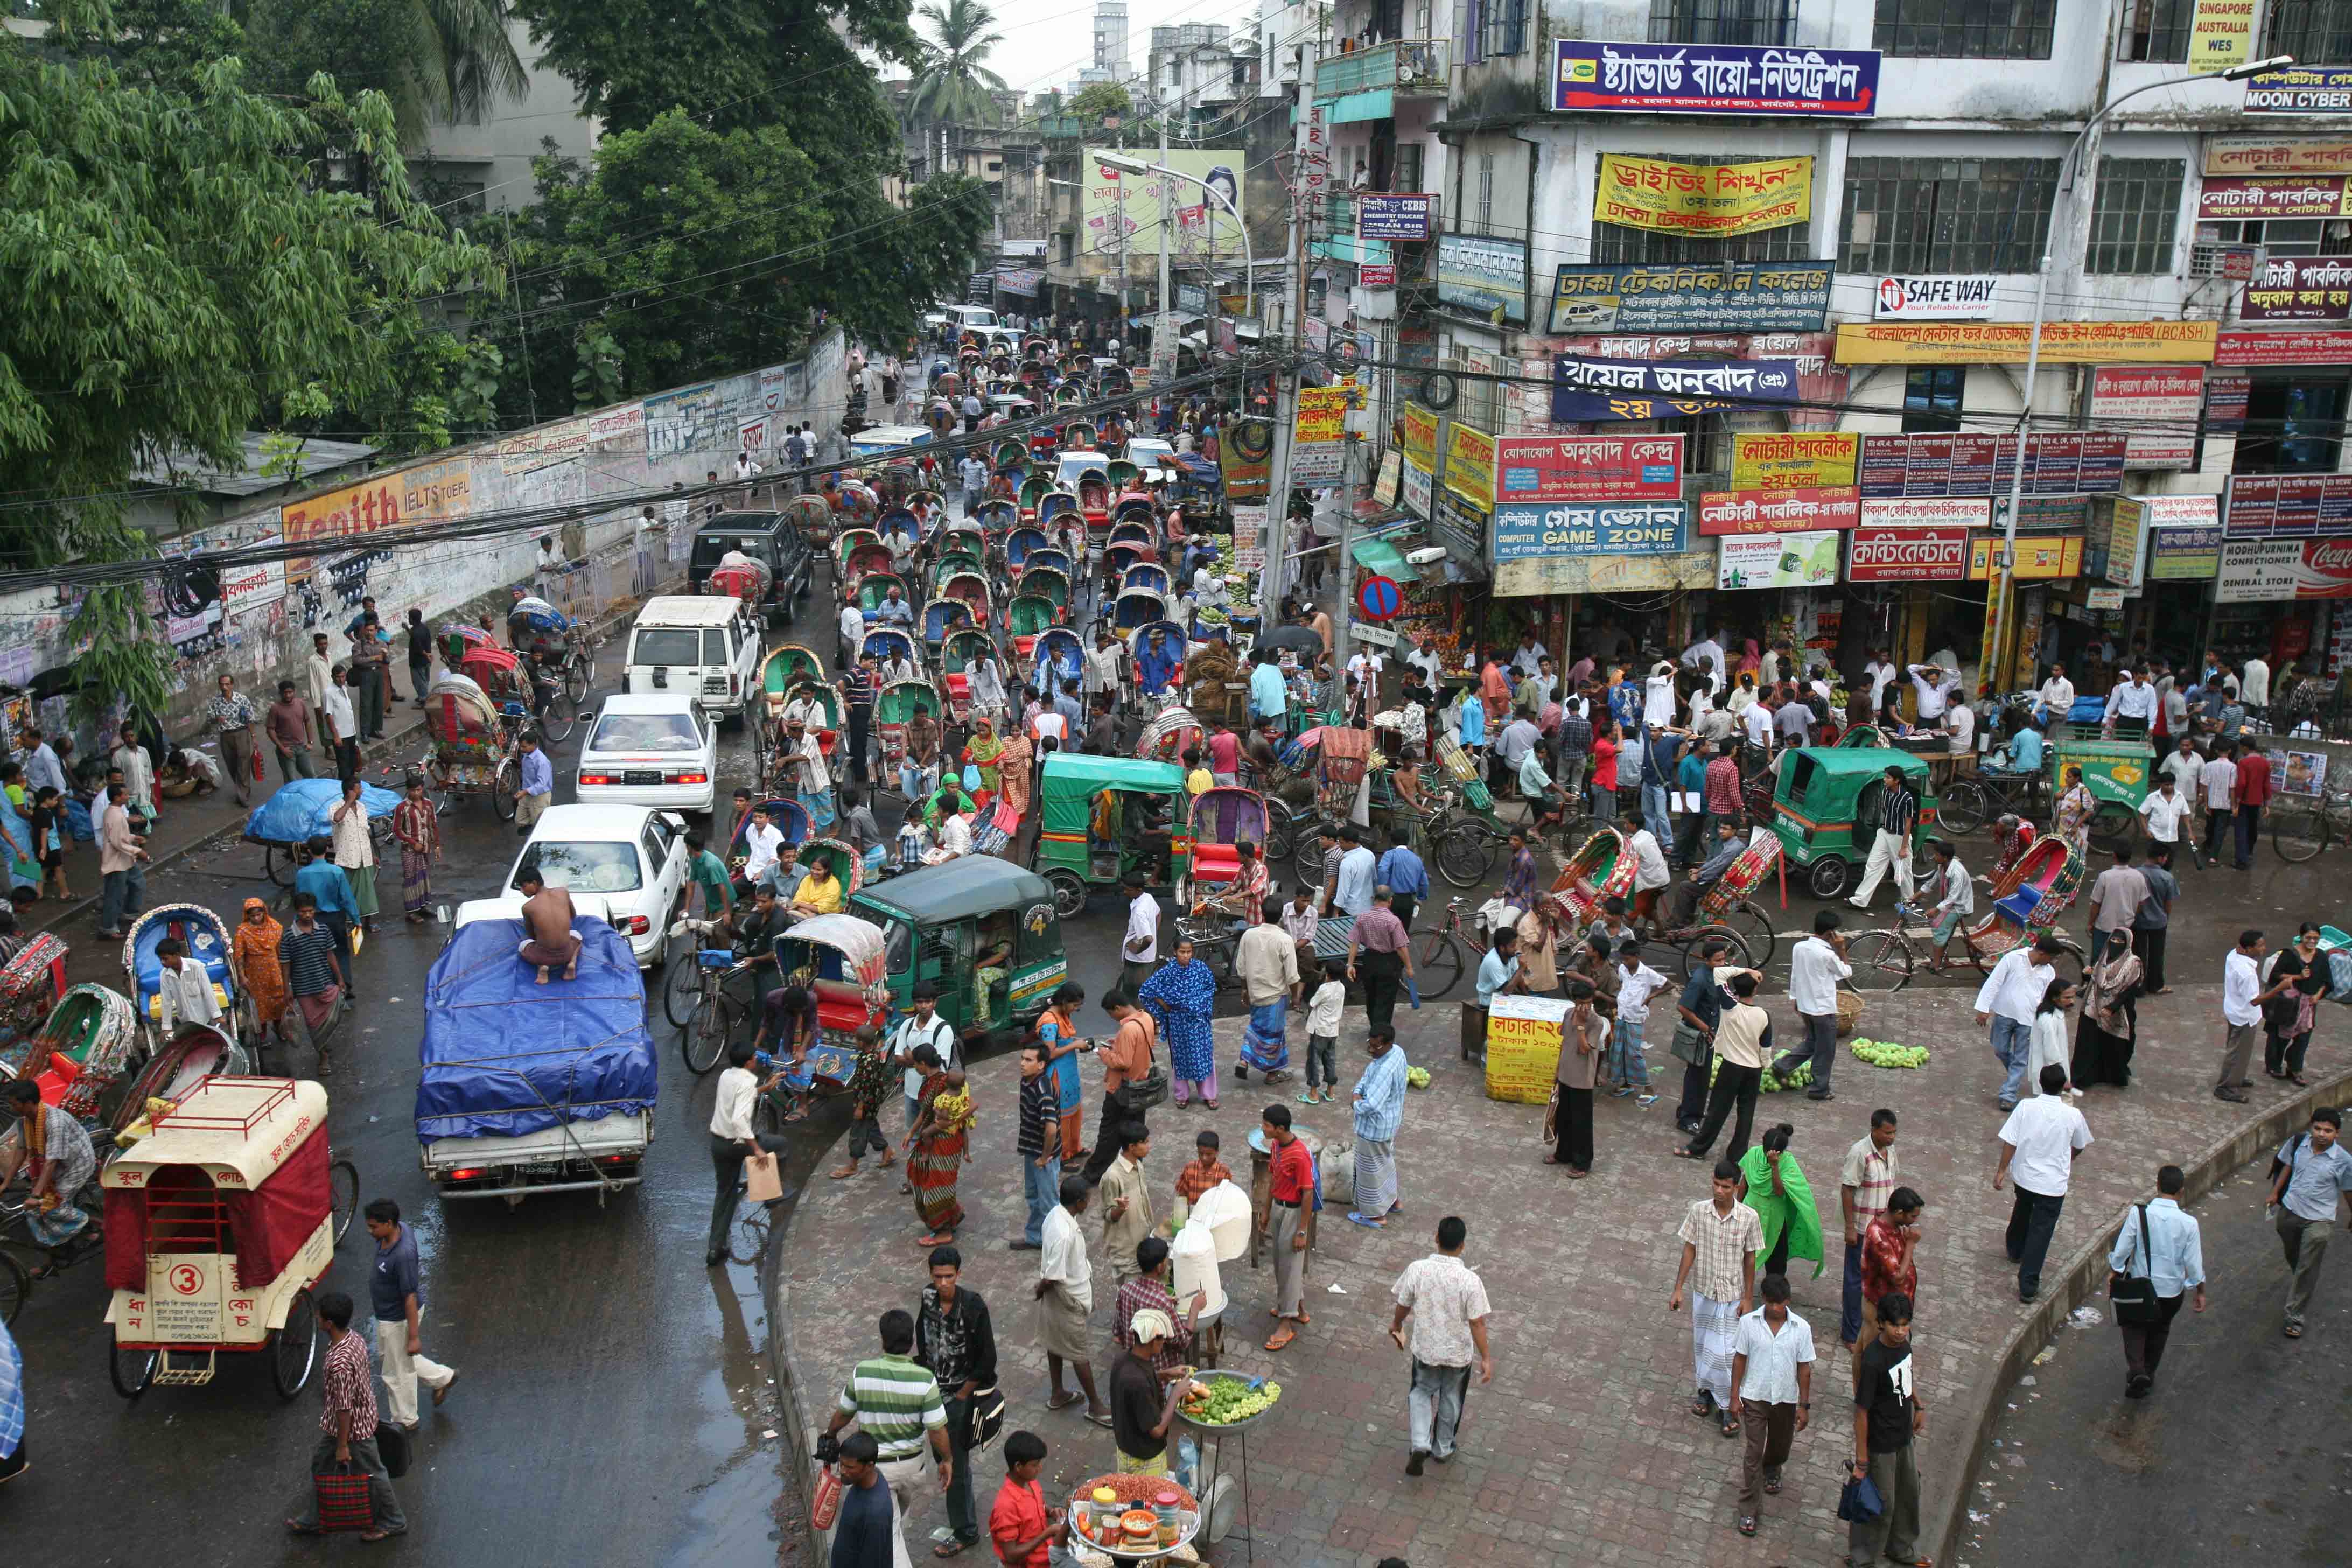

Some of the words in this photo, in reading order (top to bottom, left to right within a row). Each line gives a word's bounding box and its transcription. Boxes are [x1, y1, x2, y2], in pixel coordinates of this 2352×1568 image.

[2199, 3, 2252, 15] SINGAPORE
[2196, 22, 2249, 33] AUSTRALIA
[2208, 39, 2232, 51] WES
[2245, 92, 2294, 107] MOON
[2297, 92, 2350, 107] CYBER
[2220, 148, 2292, 164] নোটারী
[2202, 187, 2266, 205] নোটারী
[2269, 187, 2341, 205] পাবলিক
[1402, 200, 1426, 211] CEBIS
[1607, 201, 1651, 224] ঢাকা
[2209, 205, 2254, 216] অনুবাদ
[2286, 204, 2333, 214] নোটারী
[1560, 274, 1615, 294] ঢাকা
[1758, 270, 1828, 291] কলেজ
[1907, 279, 1955, 302] SAFE
[1956, 279, 1997, 302] WAY
[2249, 290, 2295, 309] অনুবাদ
[2299, 290, 2326, 306] করা
[2329, 291, 2350, 307] হয়
[1865, 326, 1921, 342] বাংলাদেশ
[1923, 325, 1961, 342] সেন্টার
[1964, 327, 1982, 341] ফর
[2072, 323, 2088, 341] ইন
[2157, 323, 2209, 341] (BCASH)
[1655, 336, 1691, 354] কেন্দ্র
[1752, 335, 1800, 350] রয়েল
[1653, 364, 1756, 395] অনুবাদ
[1503, 446, 1554, 459] যোগাযোগ
[1559, 440, 1624, 465] অনুবাদ
[1631, 441, 1676, 462] কেন্দ্র
[1743, 434, 1795, 460] নোটারী
[1789, 473, 1821, 487] তলা
[404, 484, 439, 513] IELTS
[440, 481, 470, 498] TOEFL
[1703, 492, 1739, 503] নোটারী
[1762, 489, 1797, 502] নোটারী
[1819, 487, 1853, 499] নোটারী
[288, 486, 399, 542] Zenith
[1499, 512, 1538, 529] কম্পিউটার
[1545, 506, 1596, 529] গেম
[1600, 503, 1684, 527] জোন
[1702, 500, 1759, 522] নোটারী
[1759, 499, 1819, 520] পাবলিক
[1819, 503, 1829, 516] এর
[1863, 501, 1889, 517] বিক্যাশ
[1942, 501, 1969, 517] চিকিৎসা
[1969, 505, 1988, 517] কেন্দ্র
[1499, 534, 1535, 543] COMPUTER
[1542, 530, 1596, 545] GAME
[1608, 528, 1675, 543] ZONE
[1853, 532, 1964, 563] কন্টিনেন্টাল
[2226, 543, 2300, 556] MODHUPURNIMA
[2225, 556, 2298, 566] CONFECTIONERY
[2223, 577, 2262, 587] GENERAL
[2265, 577, 2293, 586] STORE
[1030, 914, 1047, 936] 4
[117, 1171, 143, 1186] স্কুল
[216, 1172, 244, 1184] কোচ
[178, 1268, 196, 1292] 3
